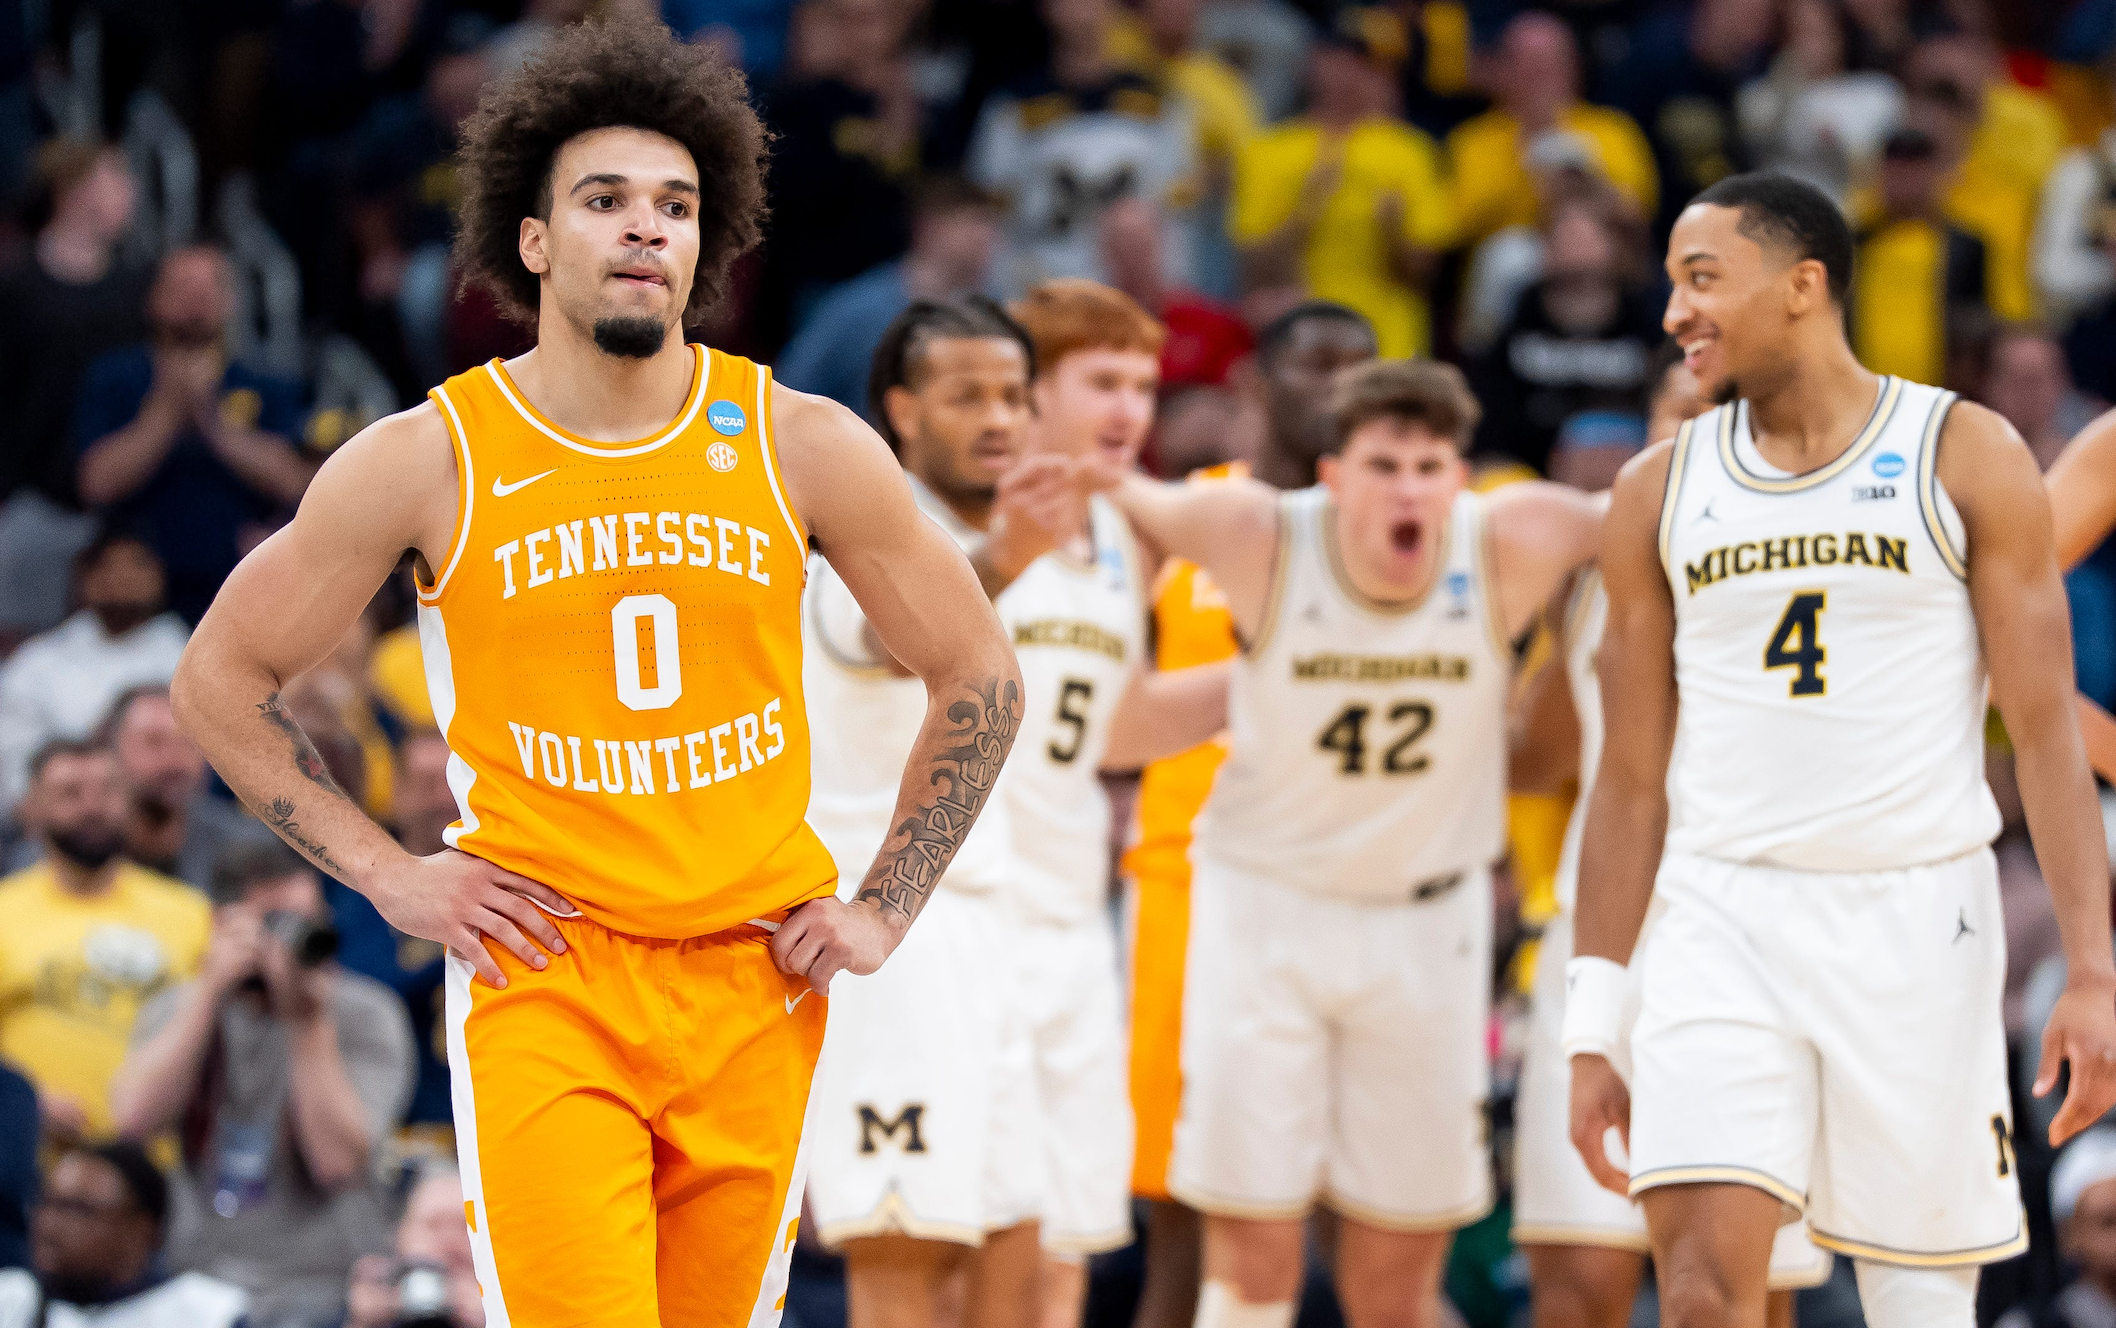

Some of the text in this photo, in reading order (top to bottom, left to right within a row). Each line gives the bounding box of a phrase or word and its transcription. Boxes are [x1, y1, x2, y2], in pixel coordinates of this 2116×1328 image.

[709, 445, 735, 469] SEC
[713, 415, 744, 428] NCAA
[494, 511, 770, 600] TENNESSEE
[1685, 532, 1911, 596] MICHIGAN
[610, 593, 683, 711] 0
[1762, 588, 1828, 698] 4
[507, 697, 786, 795] VOLUNTEERS
[1047, 677, 1095, 764] 5
[1315, 701, 1435, 776] 42
[880, 704, 1012, 921] FEARLESS
[856, 1104, 926, 1154] M
